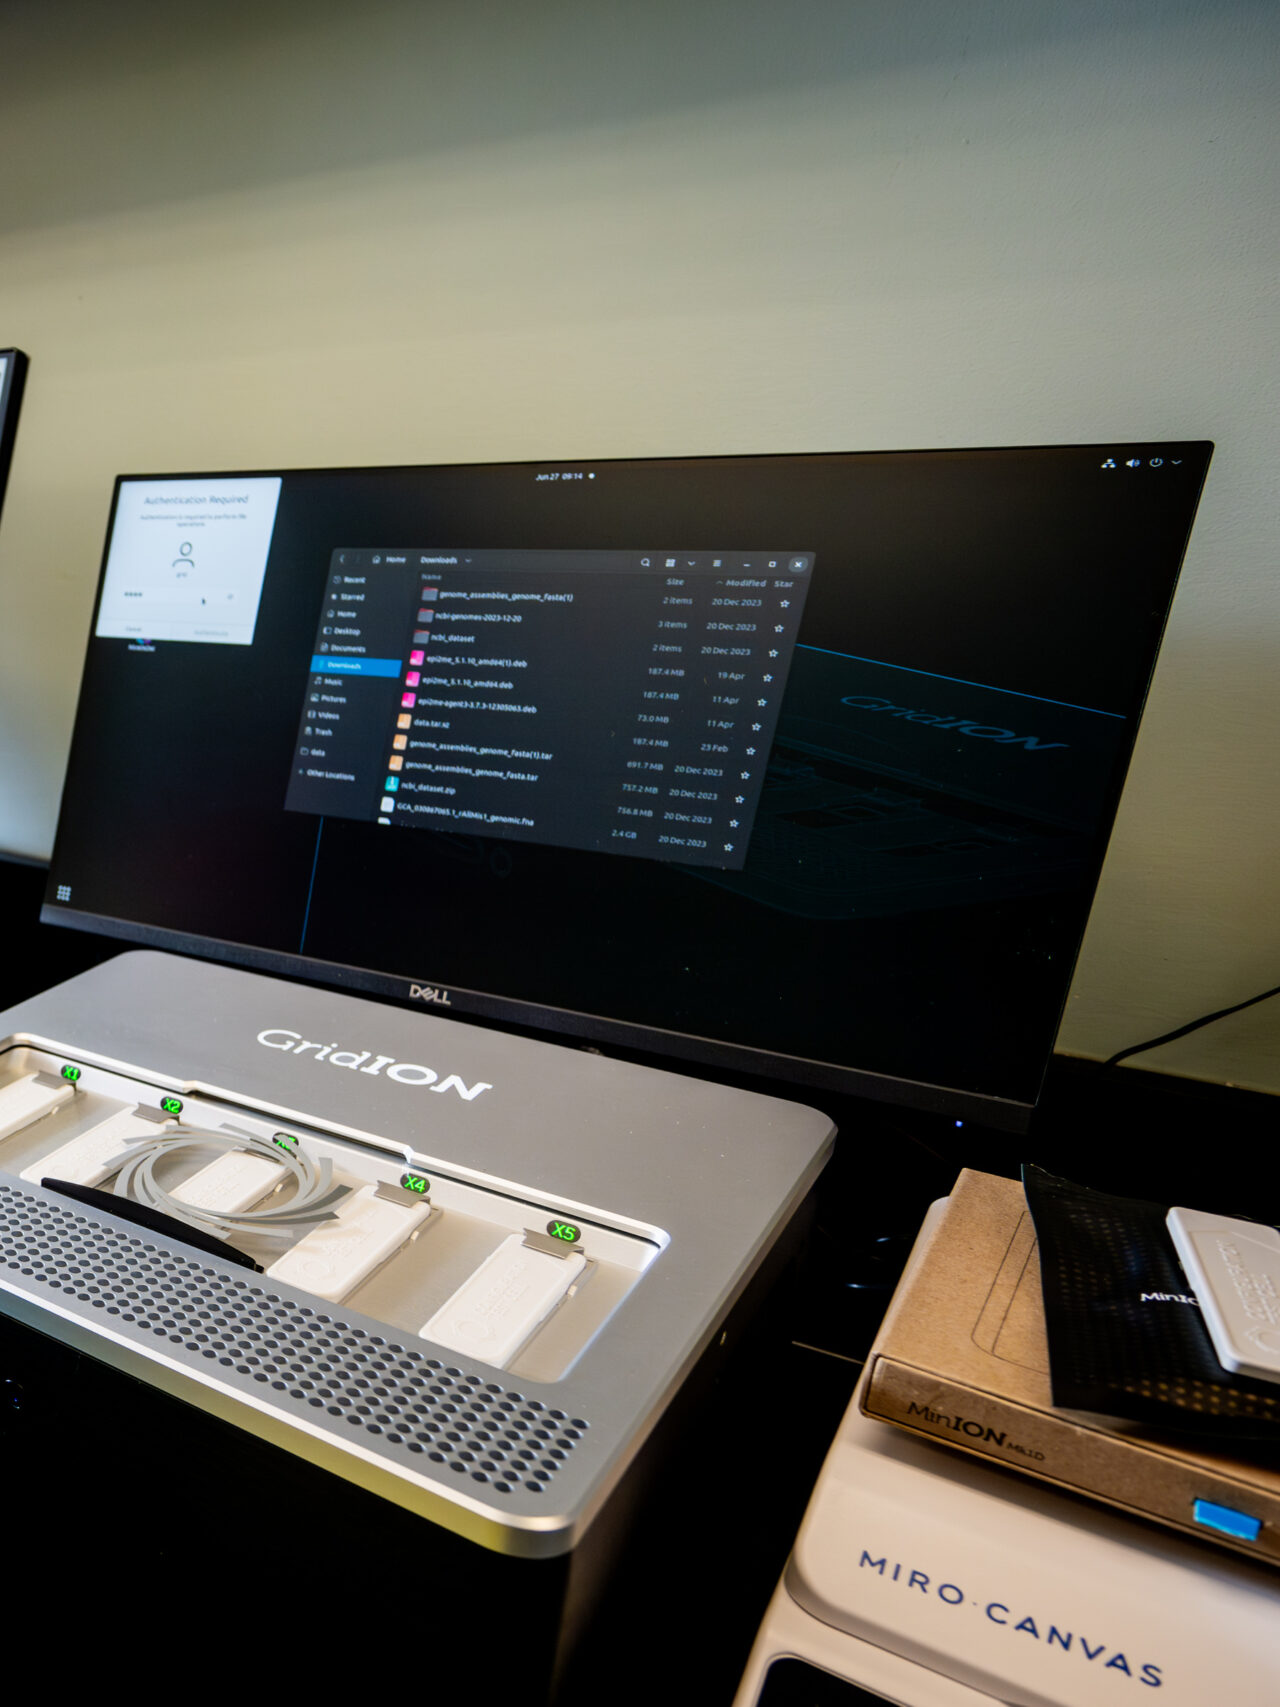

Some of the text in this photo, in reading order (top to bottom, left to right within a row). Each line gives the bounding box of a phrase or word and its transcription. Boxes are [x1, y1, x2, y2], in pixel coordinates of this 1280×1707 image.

[420, 556, 458, 564] Downloads
[344, 576, 366, 584] Recent
[667, 578, 684, 586] Size
[725, 579, 767, 588] Modified
[774, 580, 794, 588] Star
[341, 593, 365, 601] Starred
[669, 597, 693, 605] items
[723, 598, 739, 606] Dec
[741, 599, 762, 607] 2023
[337, 610, 357, 618] Home
[664, 621, 688, 629] items
[718, 623, 734, 631] Dec
[736, 623, 757, 631] 2023
[334, 627, 361, 637] Desktop
[431, 633, 476, 643] ncbi_dataset
[331, 644, 366, 653] Documents
[659, 645, 682, 653] items
[713, 646, 729, 655] Dec
[730, 648, 751, 656] 2023
[327, 661, 362, 670] Downloads
[729, 672, 745, 681] Apr
[324, 678, 343, 686] Music
[321, 694, 347, 704] Pictures
[723, 696, 739, 705] Apr
[318, 711, 340, 720] Videos
[717, 721, 735, 730] Apr
[841, 696, 1070, 750] GridION
[315, 727, 333, 736] Trash
[311, 748, 326, 757] data
[712, 744, 728, 752] Feb
[307, 769, 356, 781] Other Locations
[685, 766, 701, 774] Dec
[703, 768, 723, 776] 2023
[680, 790, 696, 798] Dec
[697, 792, 718, 800] 2023
[675, 813, 691, 821] Dec
[692, 815, 712, 824] 2023
[669, 837, 685, 845] Dec
[686, 839, 707, 847] 2023
[409, 983, 451, 1006] DELL
[257, 1027, 494, 1102] GridION
[63, 1066, 80, 1081] X1
[163, 1098, 181, 1115] X2
[404, 1175, 426, 1192] X4
[551, 1222, 576, 1241] X5
[1140, 1292, 1200, 1307] MinIO
[907, 1401, 1009, 1448] MinION
